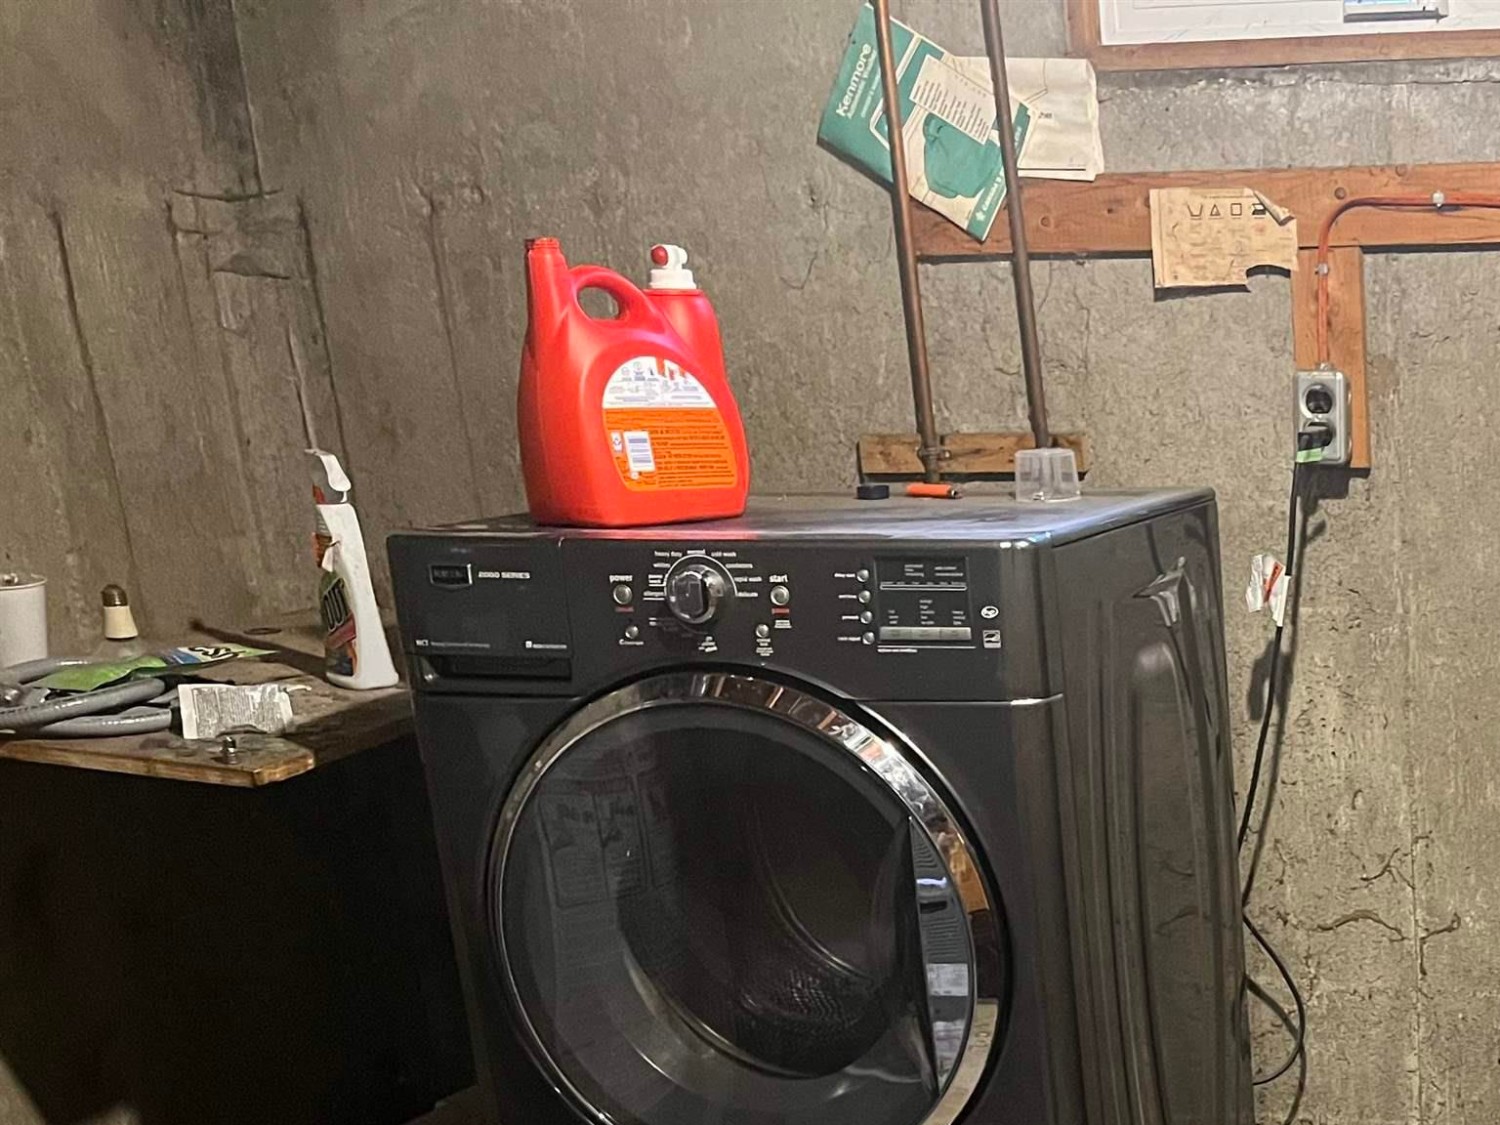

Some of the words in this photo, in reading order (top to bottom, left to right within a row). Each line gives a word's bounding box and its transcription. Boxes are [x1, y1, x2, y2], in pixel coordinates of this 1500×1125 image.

[836, 43, 872, 117] Kenmore
[609, 574, 633, 583] power
[769, 574, 788, 583] start
